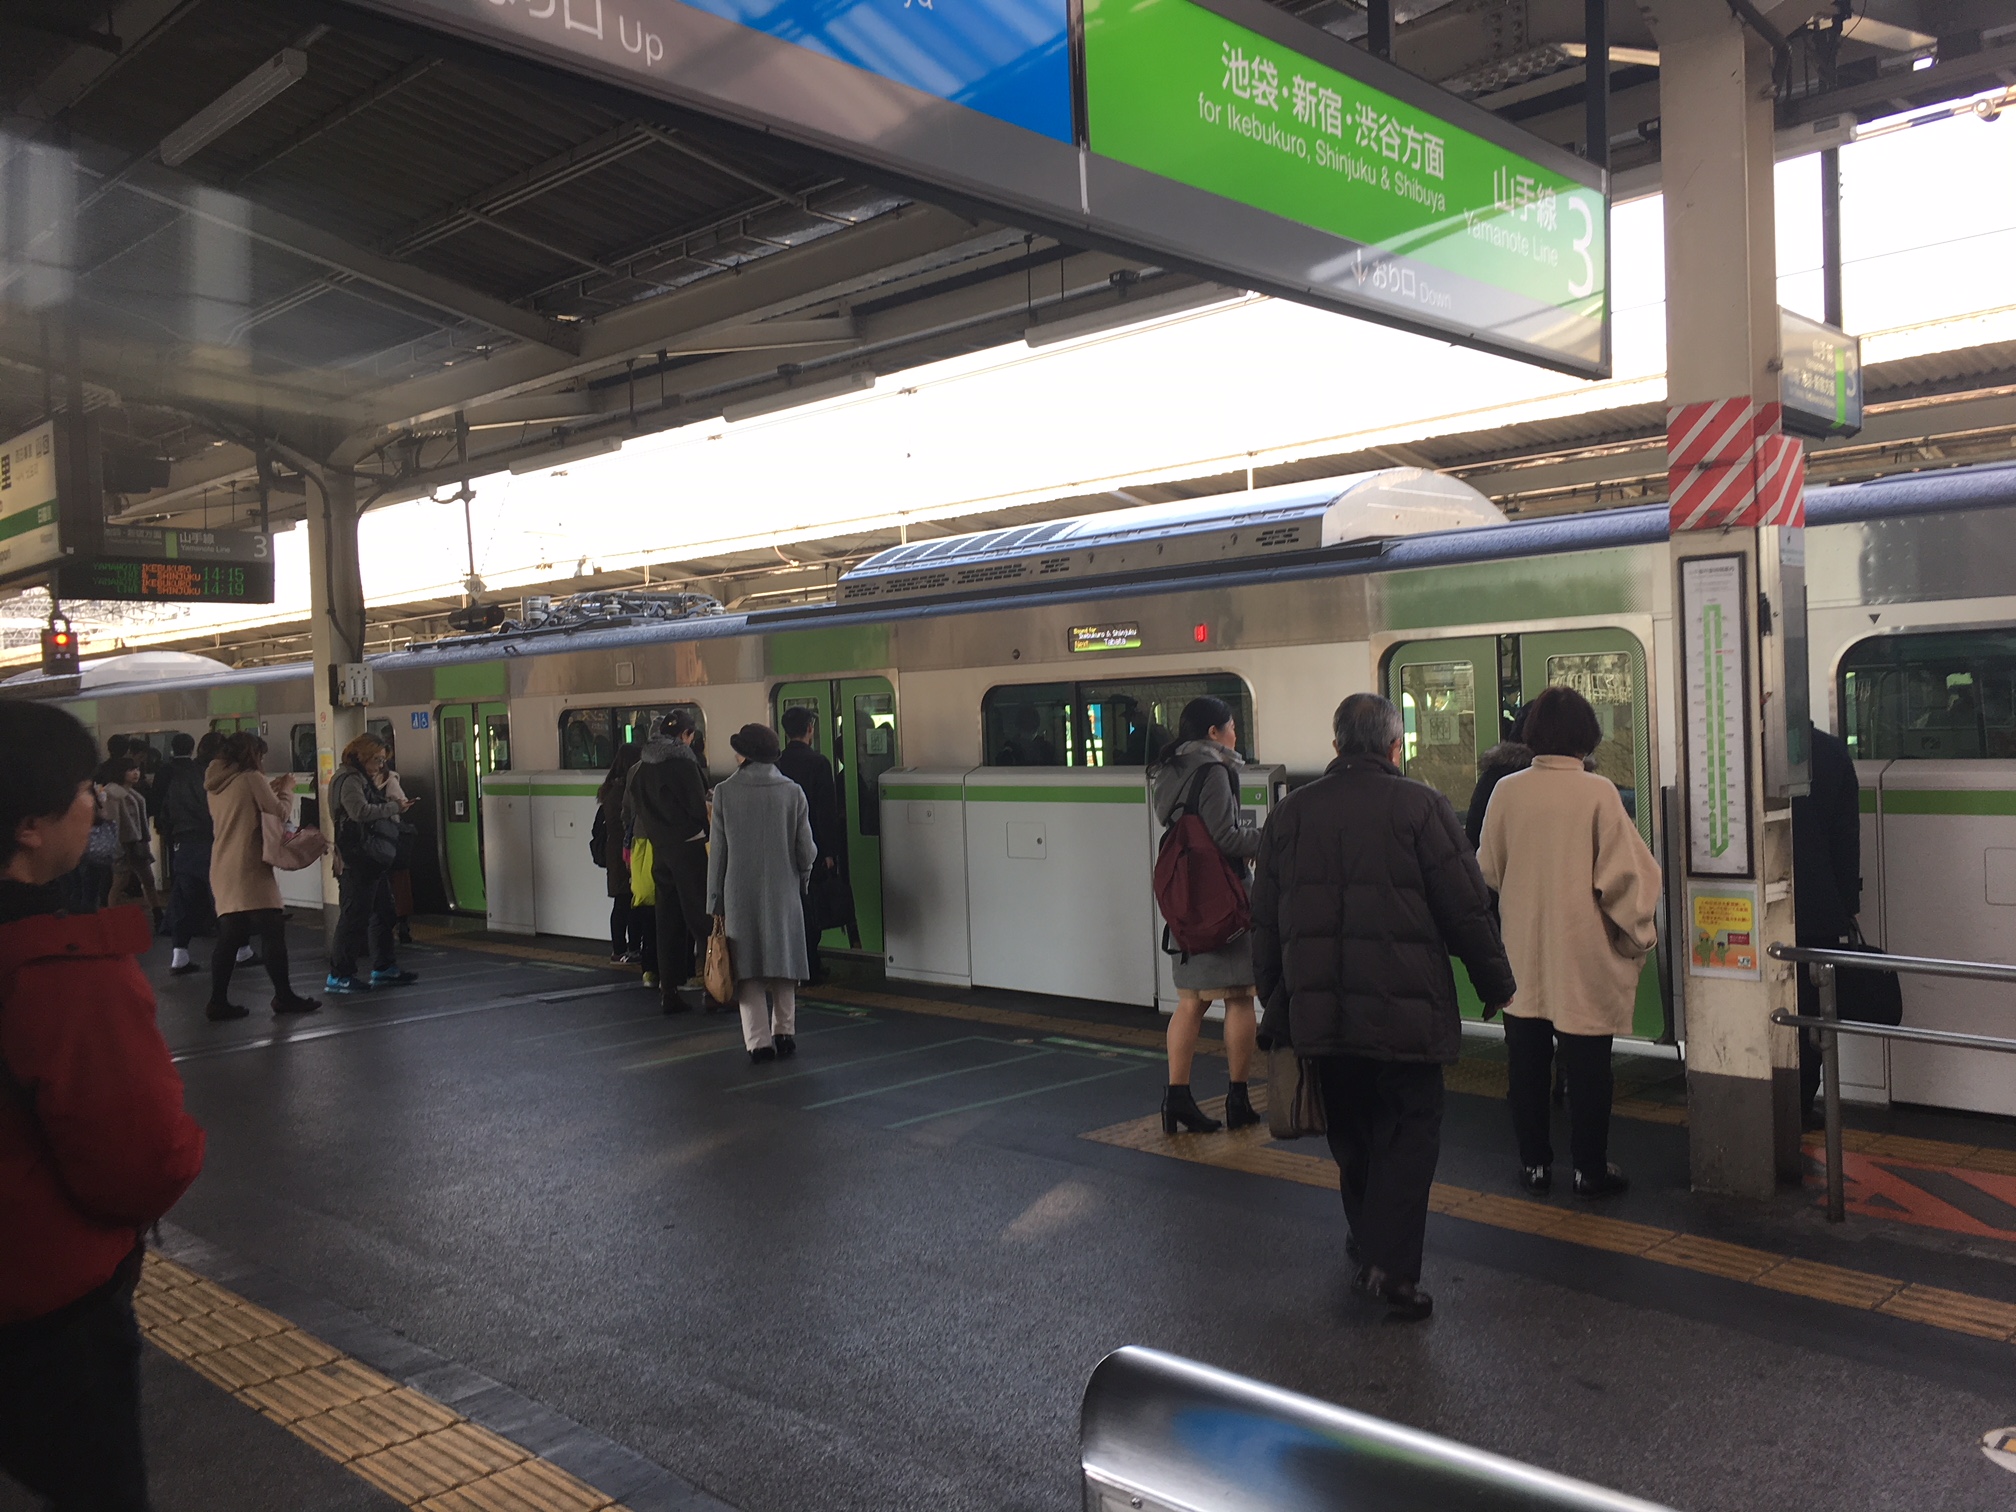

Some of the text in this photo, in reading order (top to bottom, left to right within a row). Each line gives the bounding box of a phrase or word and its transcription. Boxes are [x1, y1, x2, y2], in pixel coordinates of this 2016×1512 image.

[619, 15, 663, 67] Up
[1221, 40, 1445, 180] 池袋・新宿・渋谷方面
[1198, 91, 1446, 213] for Ikebukuro, Shinjuku & Shibuya
[1494, 165, 1557, 232] 山手線
[1463, 207, 1558, 268] Yamanote Line
[1568, 196, 1594, 299] 3
[1372, 261, 1416, 299] おり口
[1420, 282, 1451, 310] Down
[179, 532, 215, 544] 山手線
[180, 544, 231, 554] Yamanote Line
[253, 535, 268, 558] 3
[142, 564, 192, 573] IKEBUKURO
[157, 572, 201, 581] SHINJUKU
[203, 567, 245, 582] 14:15
[203, 581, 245, 597] 14:19
[1103, 637, 1127, 646] Tabata
[1112, 628, 1137, 637] Shinjuku
